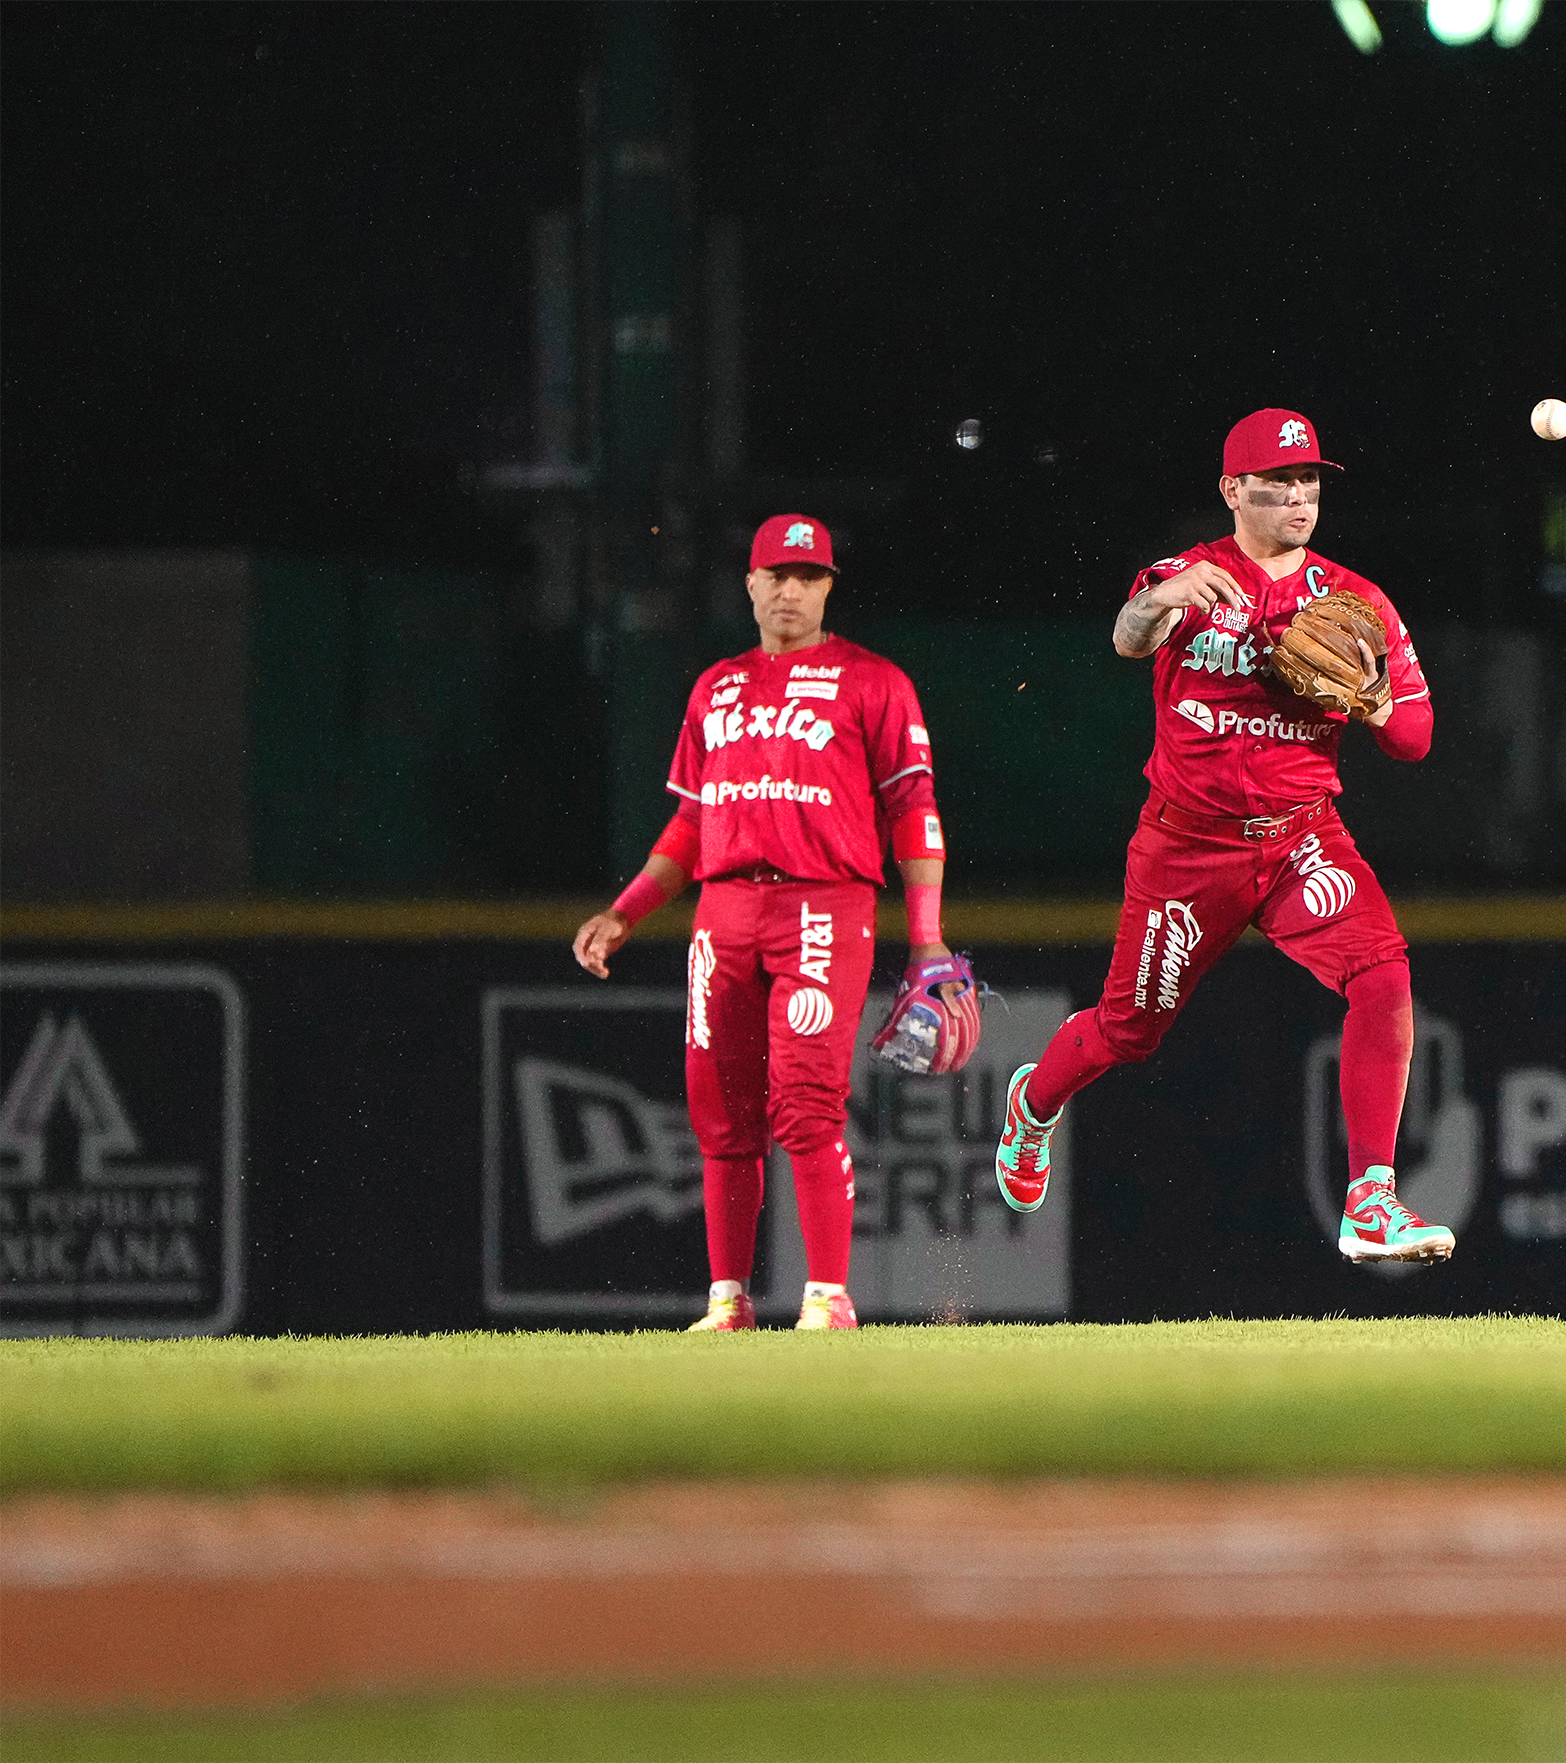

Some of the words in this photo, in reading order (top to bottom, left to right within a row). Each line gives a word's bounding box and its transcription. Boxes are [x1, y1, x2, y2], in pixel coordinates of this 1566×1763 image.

[1305, 565, 1330, 598] C
[789, 664, 841, 680] Mobil
[702, 697, 835, 752] México
[718, 774, 832, 806] Profuturo
[799, 901, 834, 985] AT&T
[1134, 929, 1157, 1009] caliente.mx
